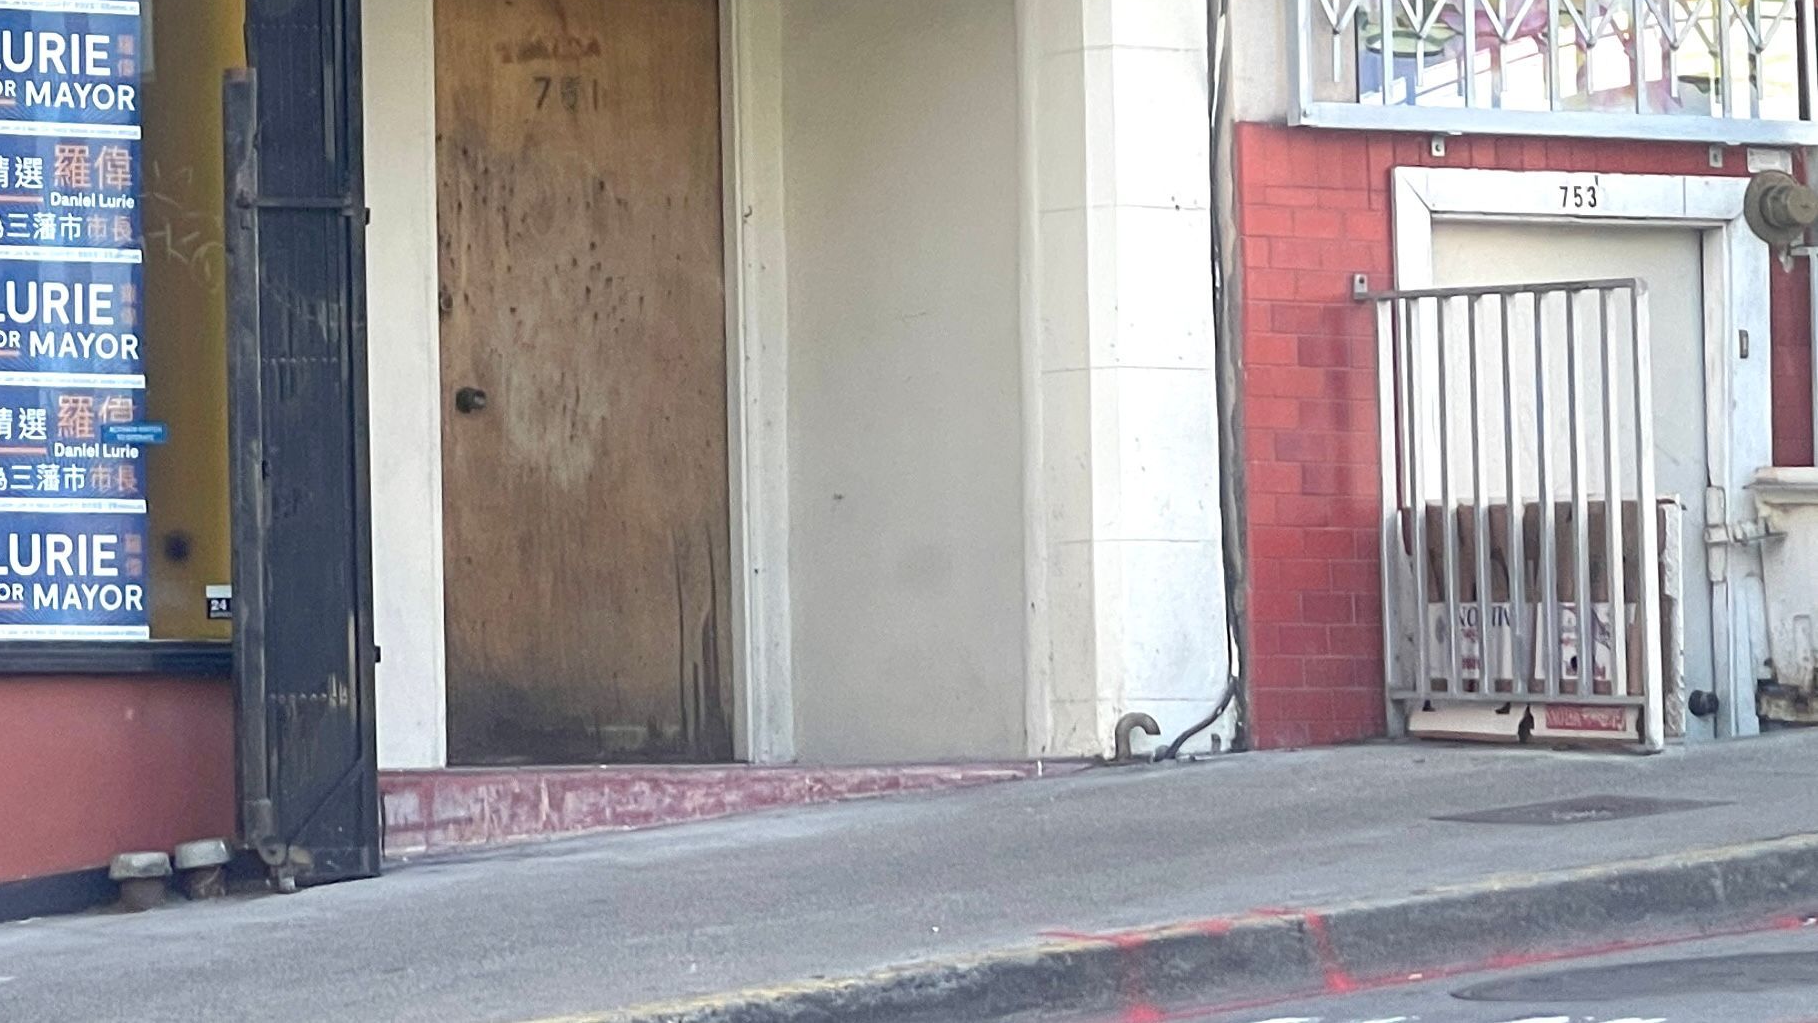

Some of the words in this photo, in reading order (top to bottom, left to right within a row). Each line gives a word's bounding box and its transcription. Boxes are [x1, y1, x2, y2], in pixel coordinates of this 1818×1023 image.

[26, 82, 134, 110] MAYOR
[53, 144, 132, 190] 羅偉
[50, 192, 94, 207] Daniel
[98, 194, 134, 209] Lurie
[1559, 184, 1599, 210] 753
[30, 333, 139, 361] MAYOR
[54, 443, 100, 458] Daniel
[103, 444, 139, 460] Lurie
[33, 584, 143, 611] MAYOR
[210, 600, 227, 610] 24
